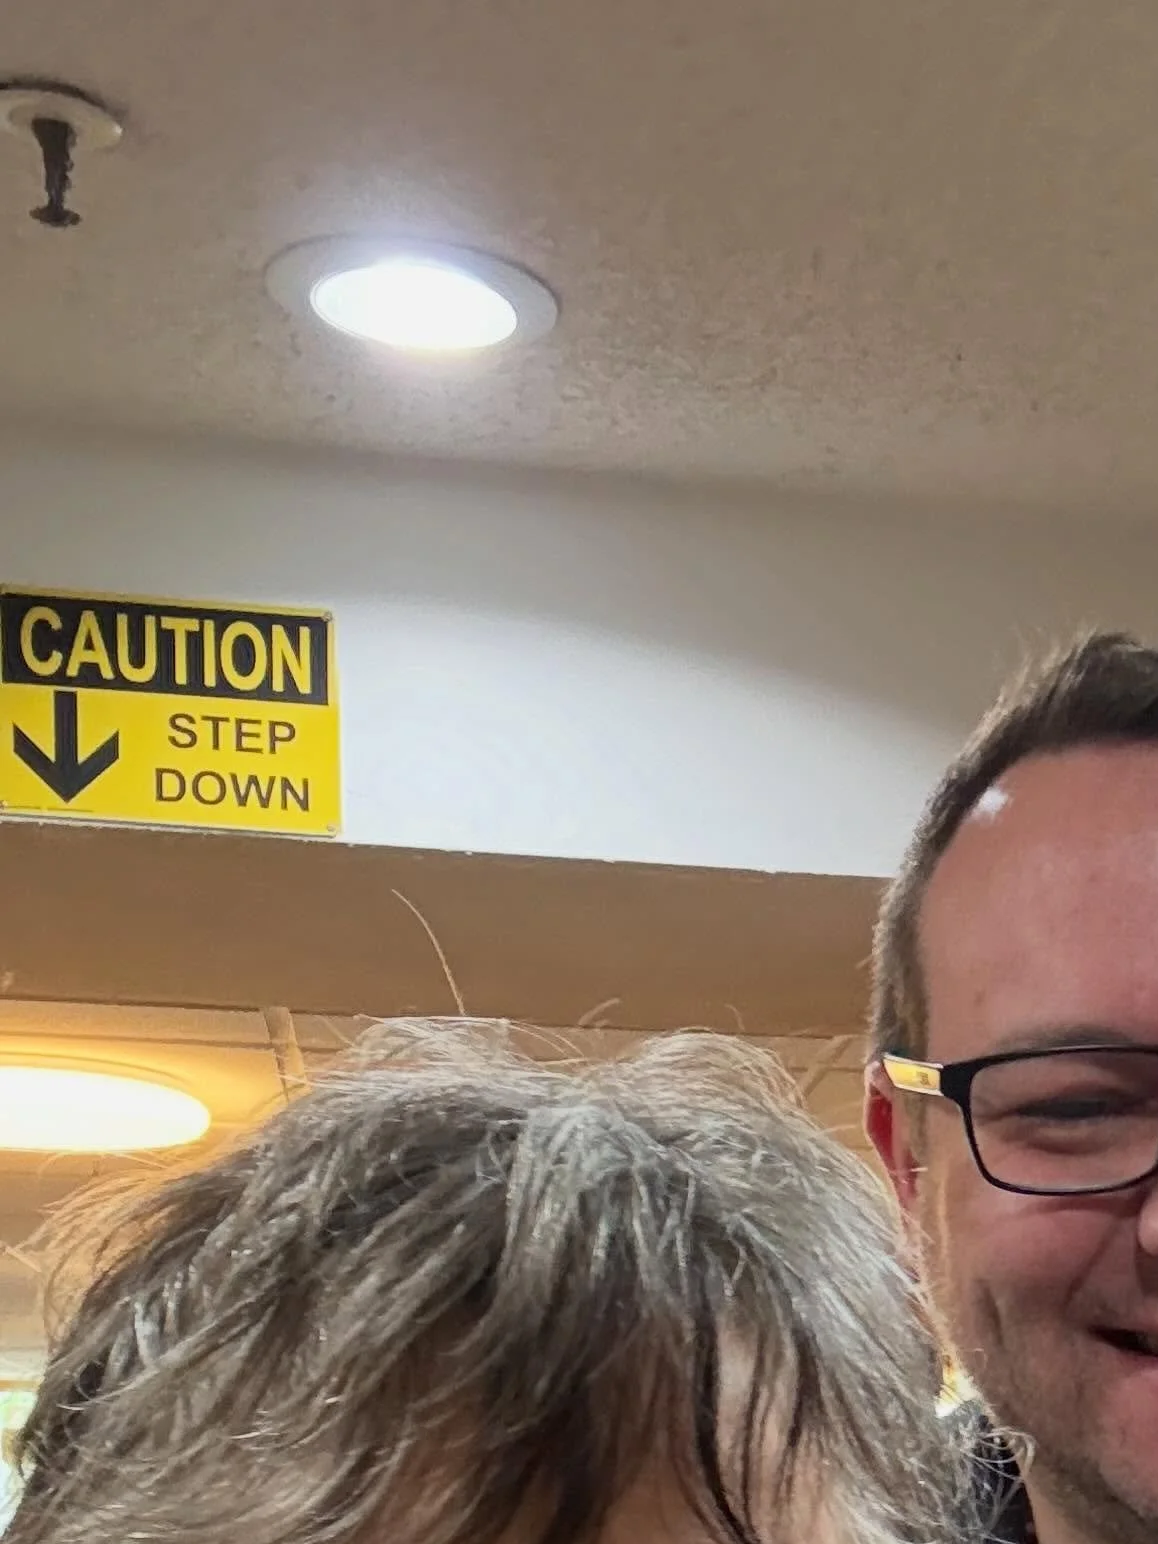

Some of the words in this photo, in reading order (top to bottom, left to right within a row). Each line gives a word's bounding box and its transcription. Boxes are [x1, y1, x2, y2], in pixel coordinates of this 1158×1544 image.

[20, 606, 311, 694] CAUTION
[168, 713, 296, 755] STEP
[155, 767, 310, 812] DOWN
